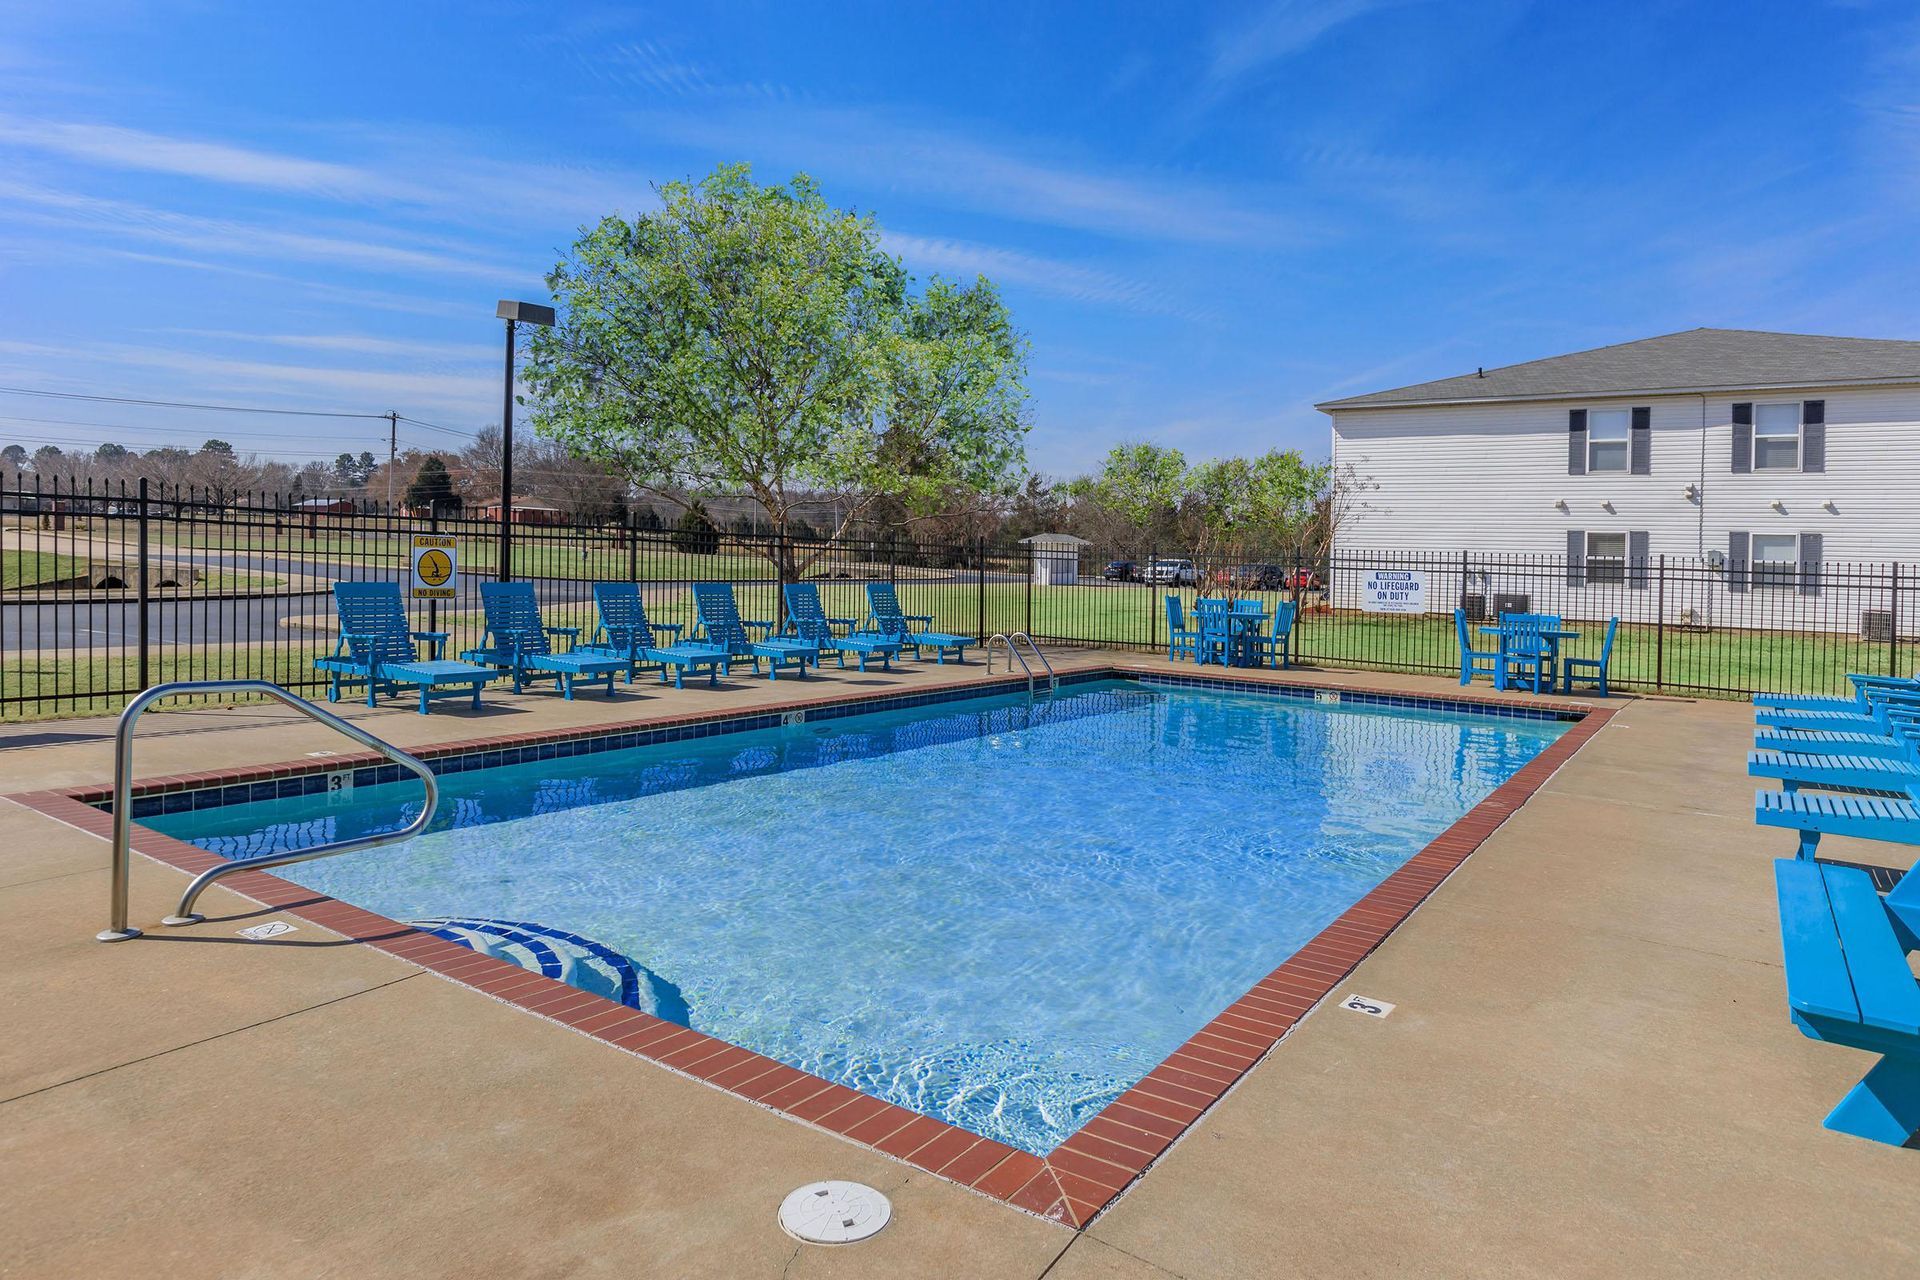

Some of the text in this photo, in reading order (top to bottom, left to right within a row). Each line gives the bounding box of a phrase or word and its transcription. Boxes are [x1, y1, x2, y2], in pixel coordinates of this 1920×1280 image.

[420, 538, 451, 547] CAUTION
[1378, 572, 1409, 580] WARNING
[1368, 581, 1419, 591] NO LIFEGUARD
[1377, 591, 1409, 600] ON DUTY
[1316, 691, 1322, 699] 5
[783, 715, 788, 725] 4
[331, 775, 342, 790] 3
[1348, 1001, 1382, 1014] 3
